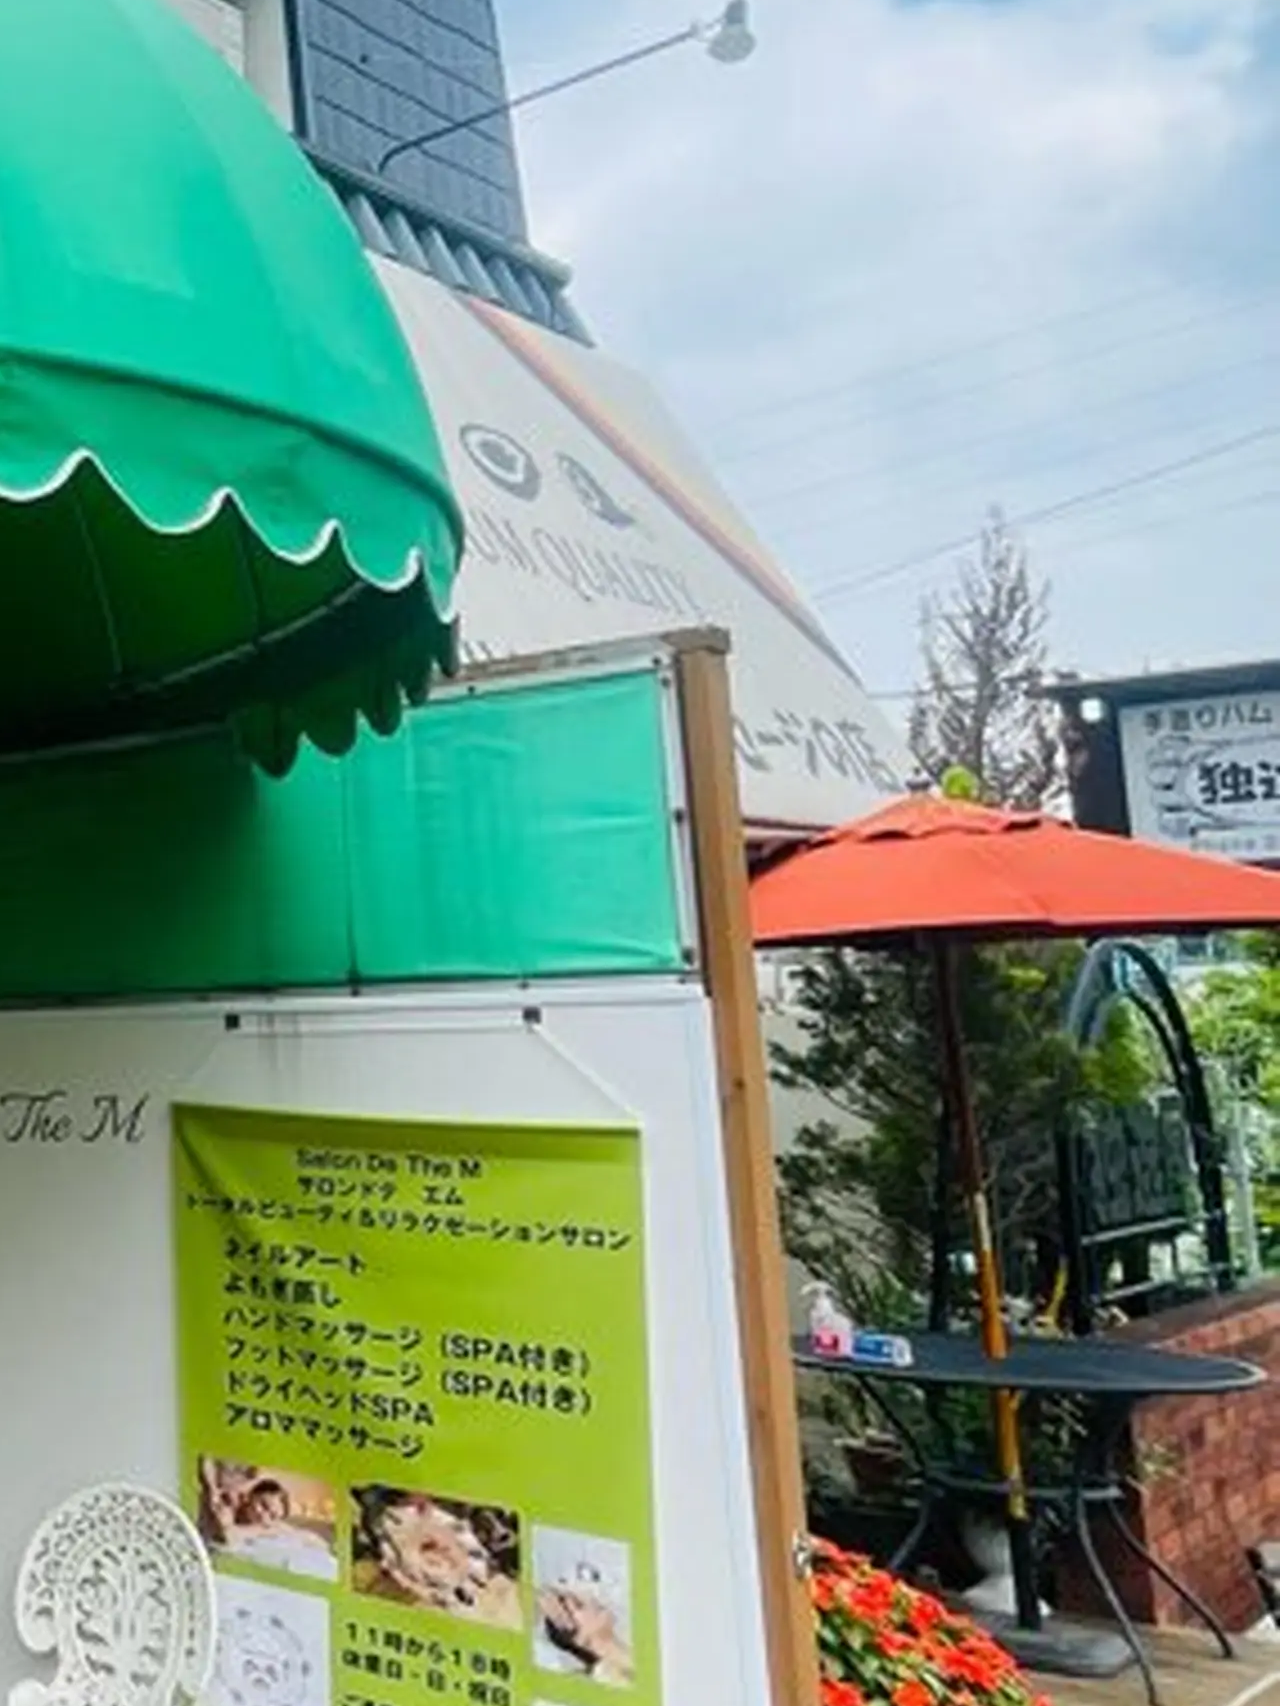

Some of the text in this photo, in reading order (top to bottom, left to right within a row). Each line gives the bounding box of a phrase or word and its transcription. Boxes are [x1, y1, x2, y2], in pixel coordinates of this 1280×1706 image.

[0, 1089, 73, 1142] The
[78, 1091, 149, 1142] M
[297, 1148, 482, 1178] Salon De The M
[422, 1185, 463, 1206] エム
[224, 1238, 366, 1276] ネイルアート
[223, 1306, 424, 1352] ハンドマッサージ
[224, 1336, 425, 1389] フットマッサージ
[224, 1370, 436, 1428] ドライヘッドSPA
[224, 1402, 426, 1461] アロママッサージ
